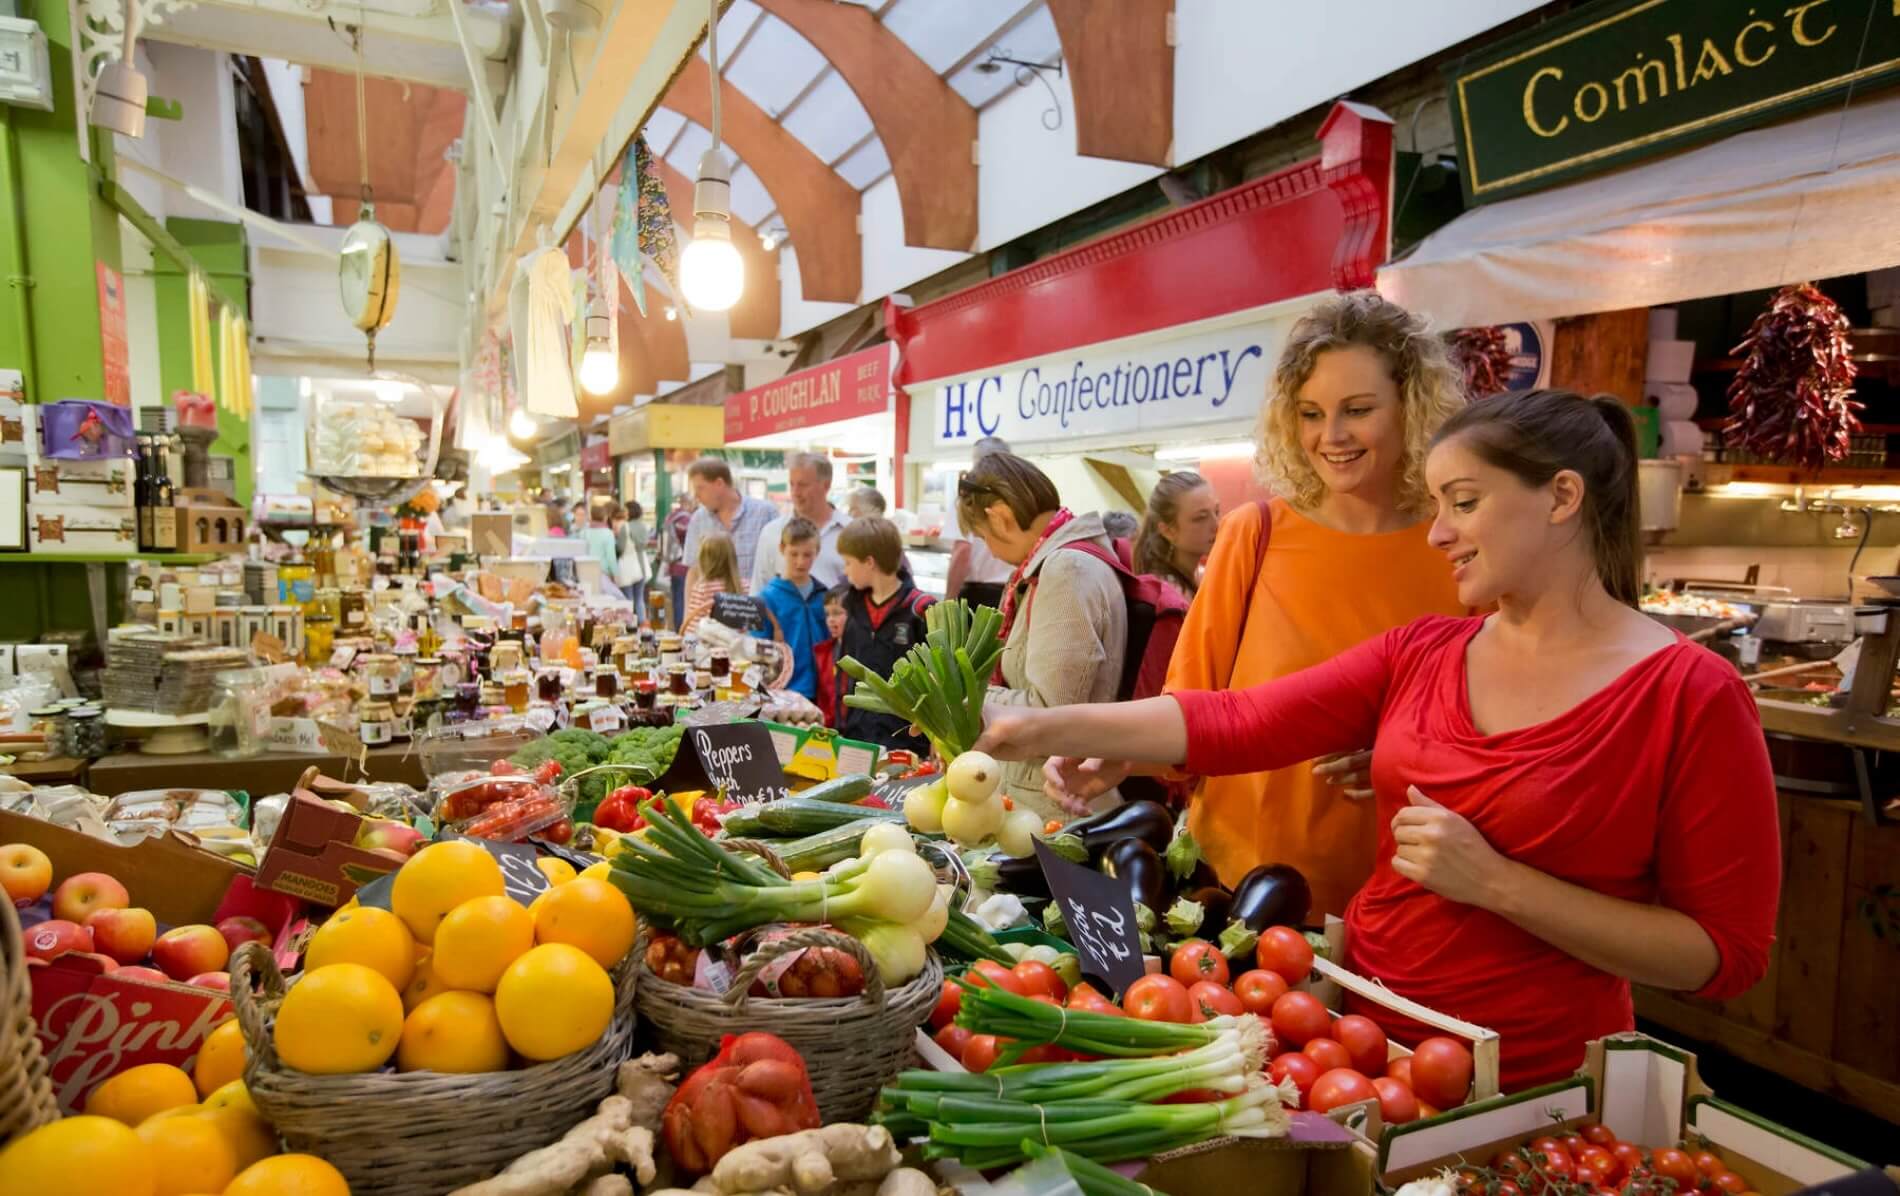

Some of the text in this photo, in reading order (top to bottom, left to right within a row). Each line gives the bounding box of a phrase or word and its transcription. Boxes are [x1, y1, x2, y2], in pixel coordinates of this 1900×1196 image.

[763, 370, 842, 417] COUGHLAN
[856, 360, 880, 382] BEEF
[1018, 345, 1263, 429] Confectionery
[696, 729, 753, 776] Peppers
[280, 870, 338, 896] MANGOES
[37, 992, 235, 1064] Pink
